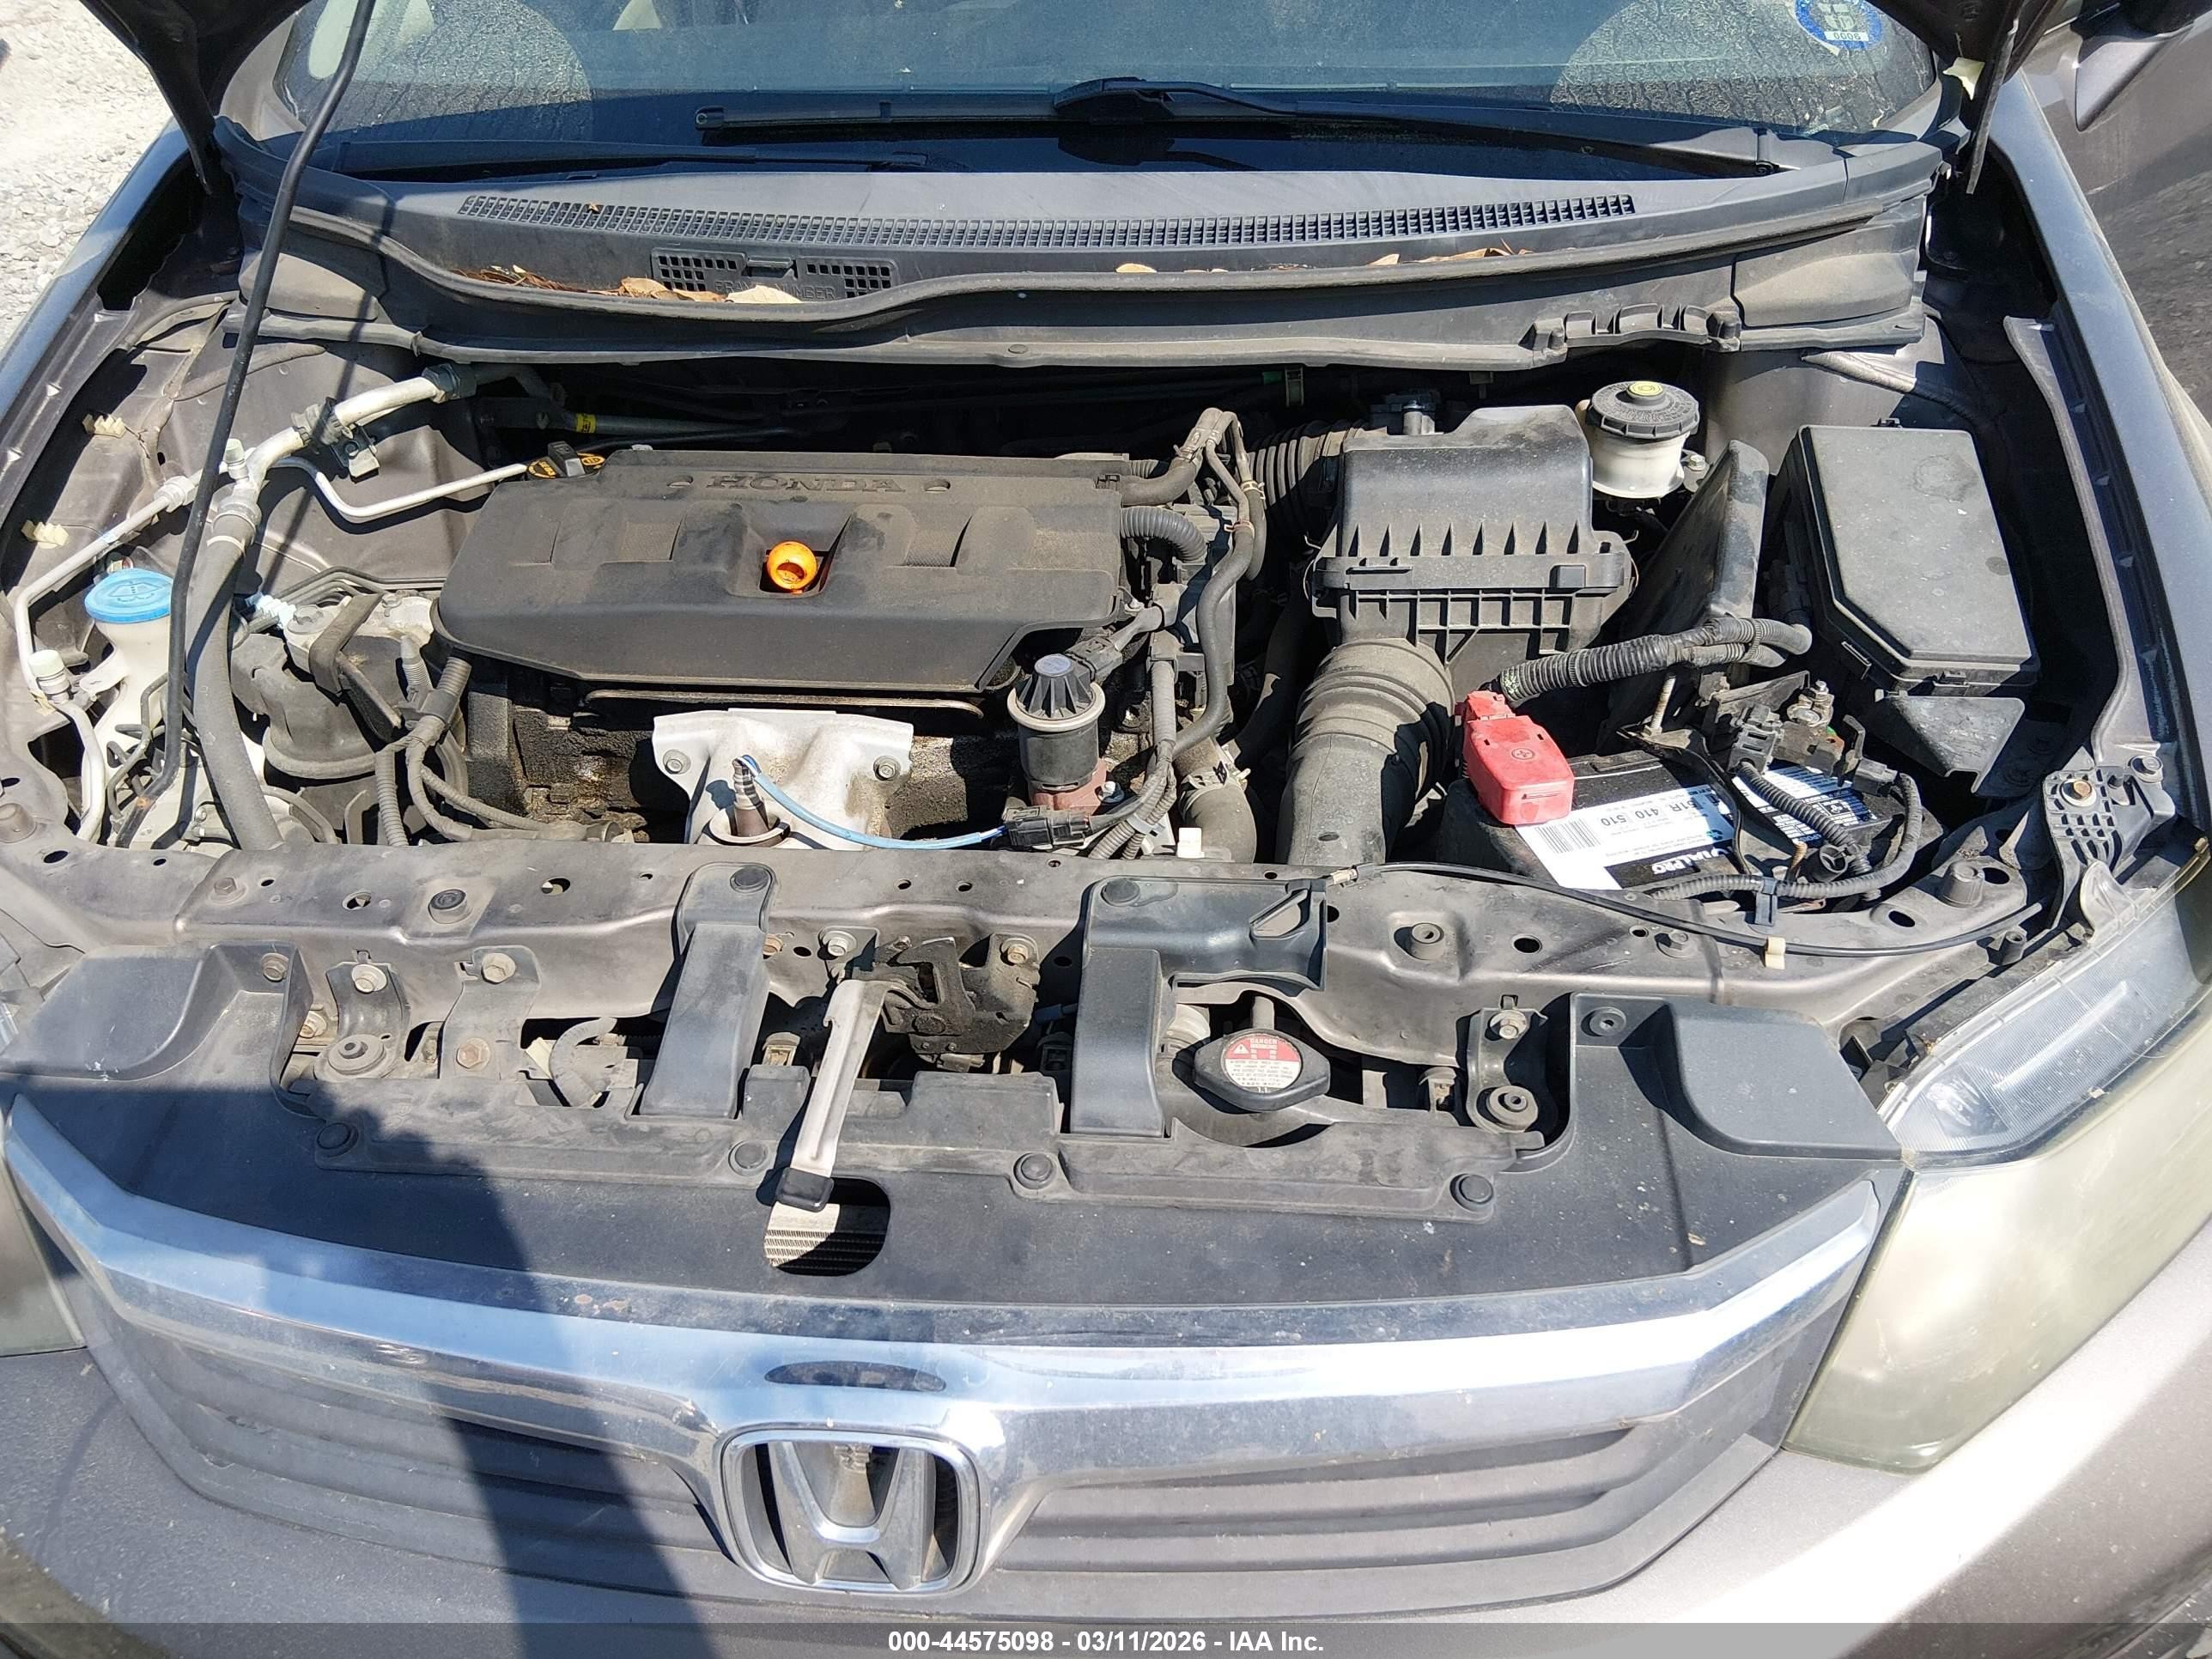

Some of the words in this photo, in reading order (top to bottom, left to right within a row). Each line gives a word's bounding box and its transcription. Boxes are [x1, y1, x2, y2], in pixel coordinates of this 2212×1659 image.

[706, 474, 907, 493] HONDA
[1600, 813, 1627, 826] 510
[1633, 807, 1659, 819] 410
